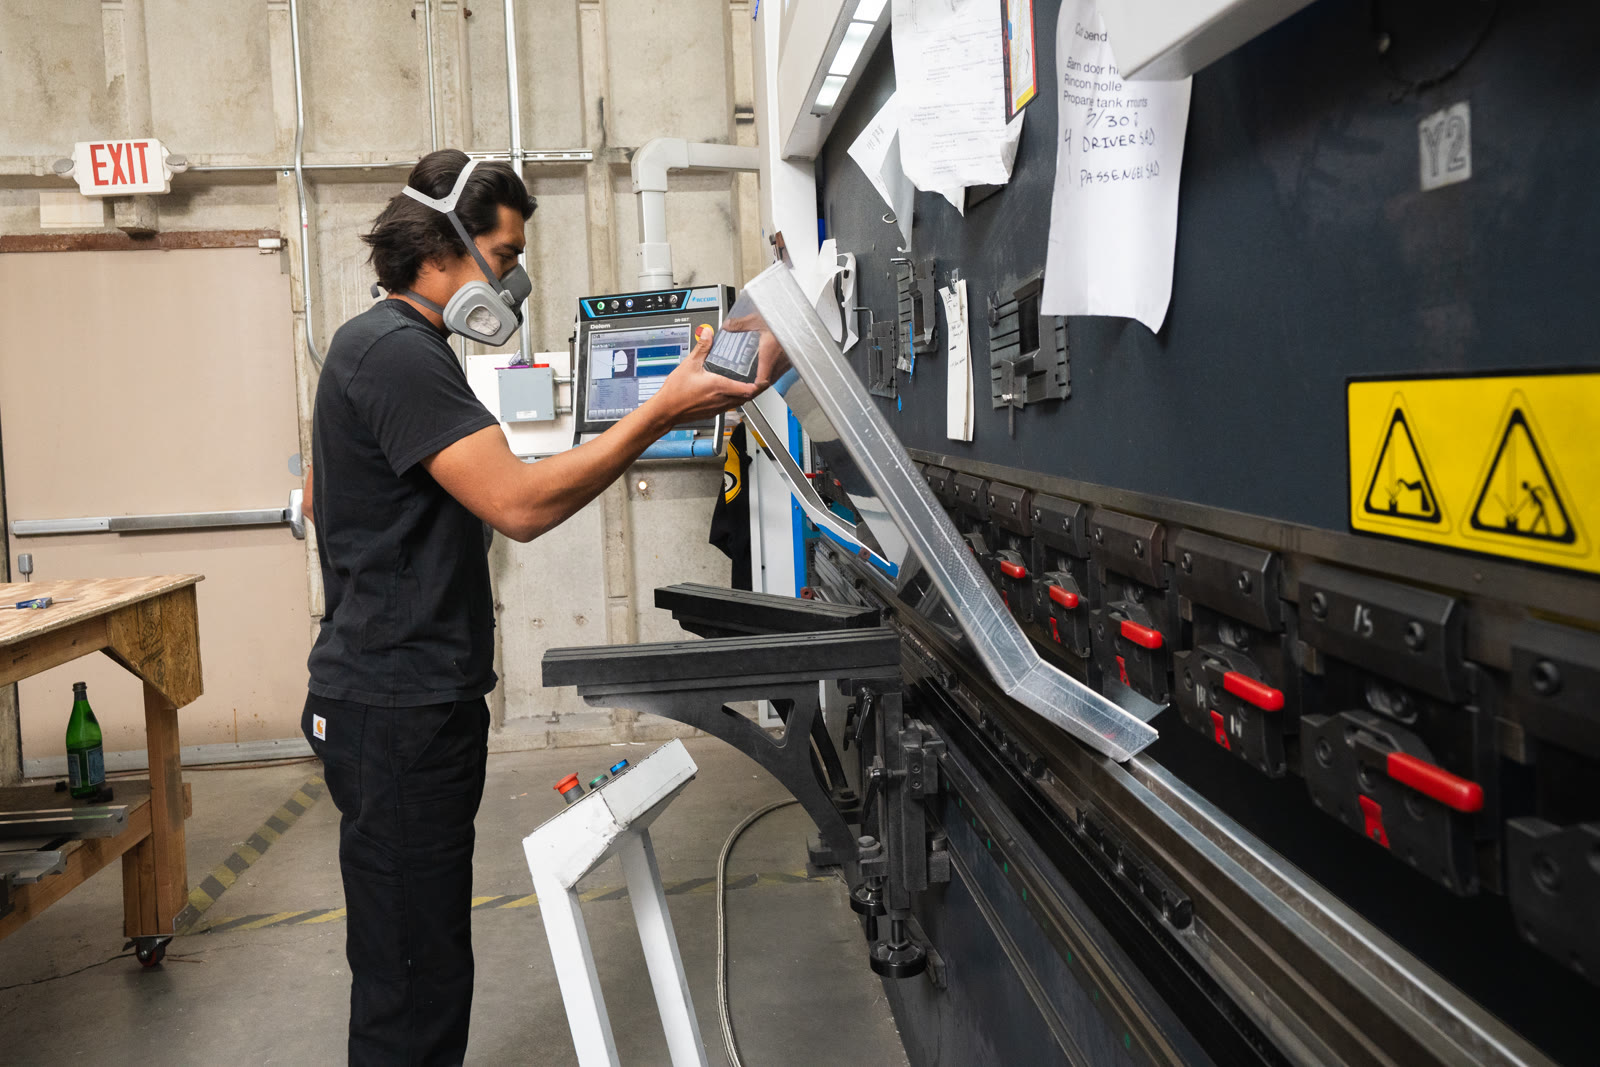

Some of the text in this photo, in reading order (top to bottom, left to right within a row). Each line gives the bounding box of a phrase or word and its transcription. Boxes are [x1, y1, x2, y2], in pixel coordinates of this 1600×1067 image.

[1096, 97, 1123, 108] tank
[1083, 134, 1137, 153] DRIVER
[1422, 115, 1466, 178] Y2
[89, 142, 149, 186] EXIT
[1353, 604, 1373, 638] 15
